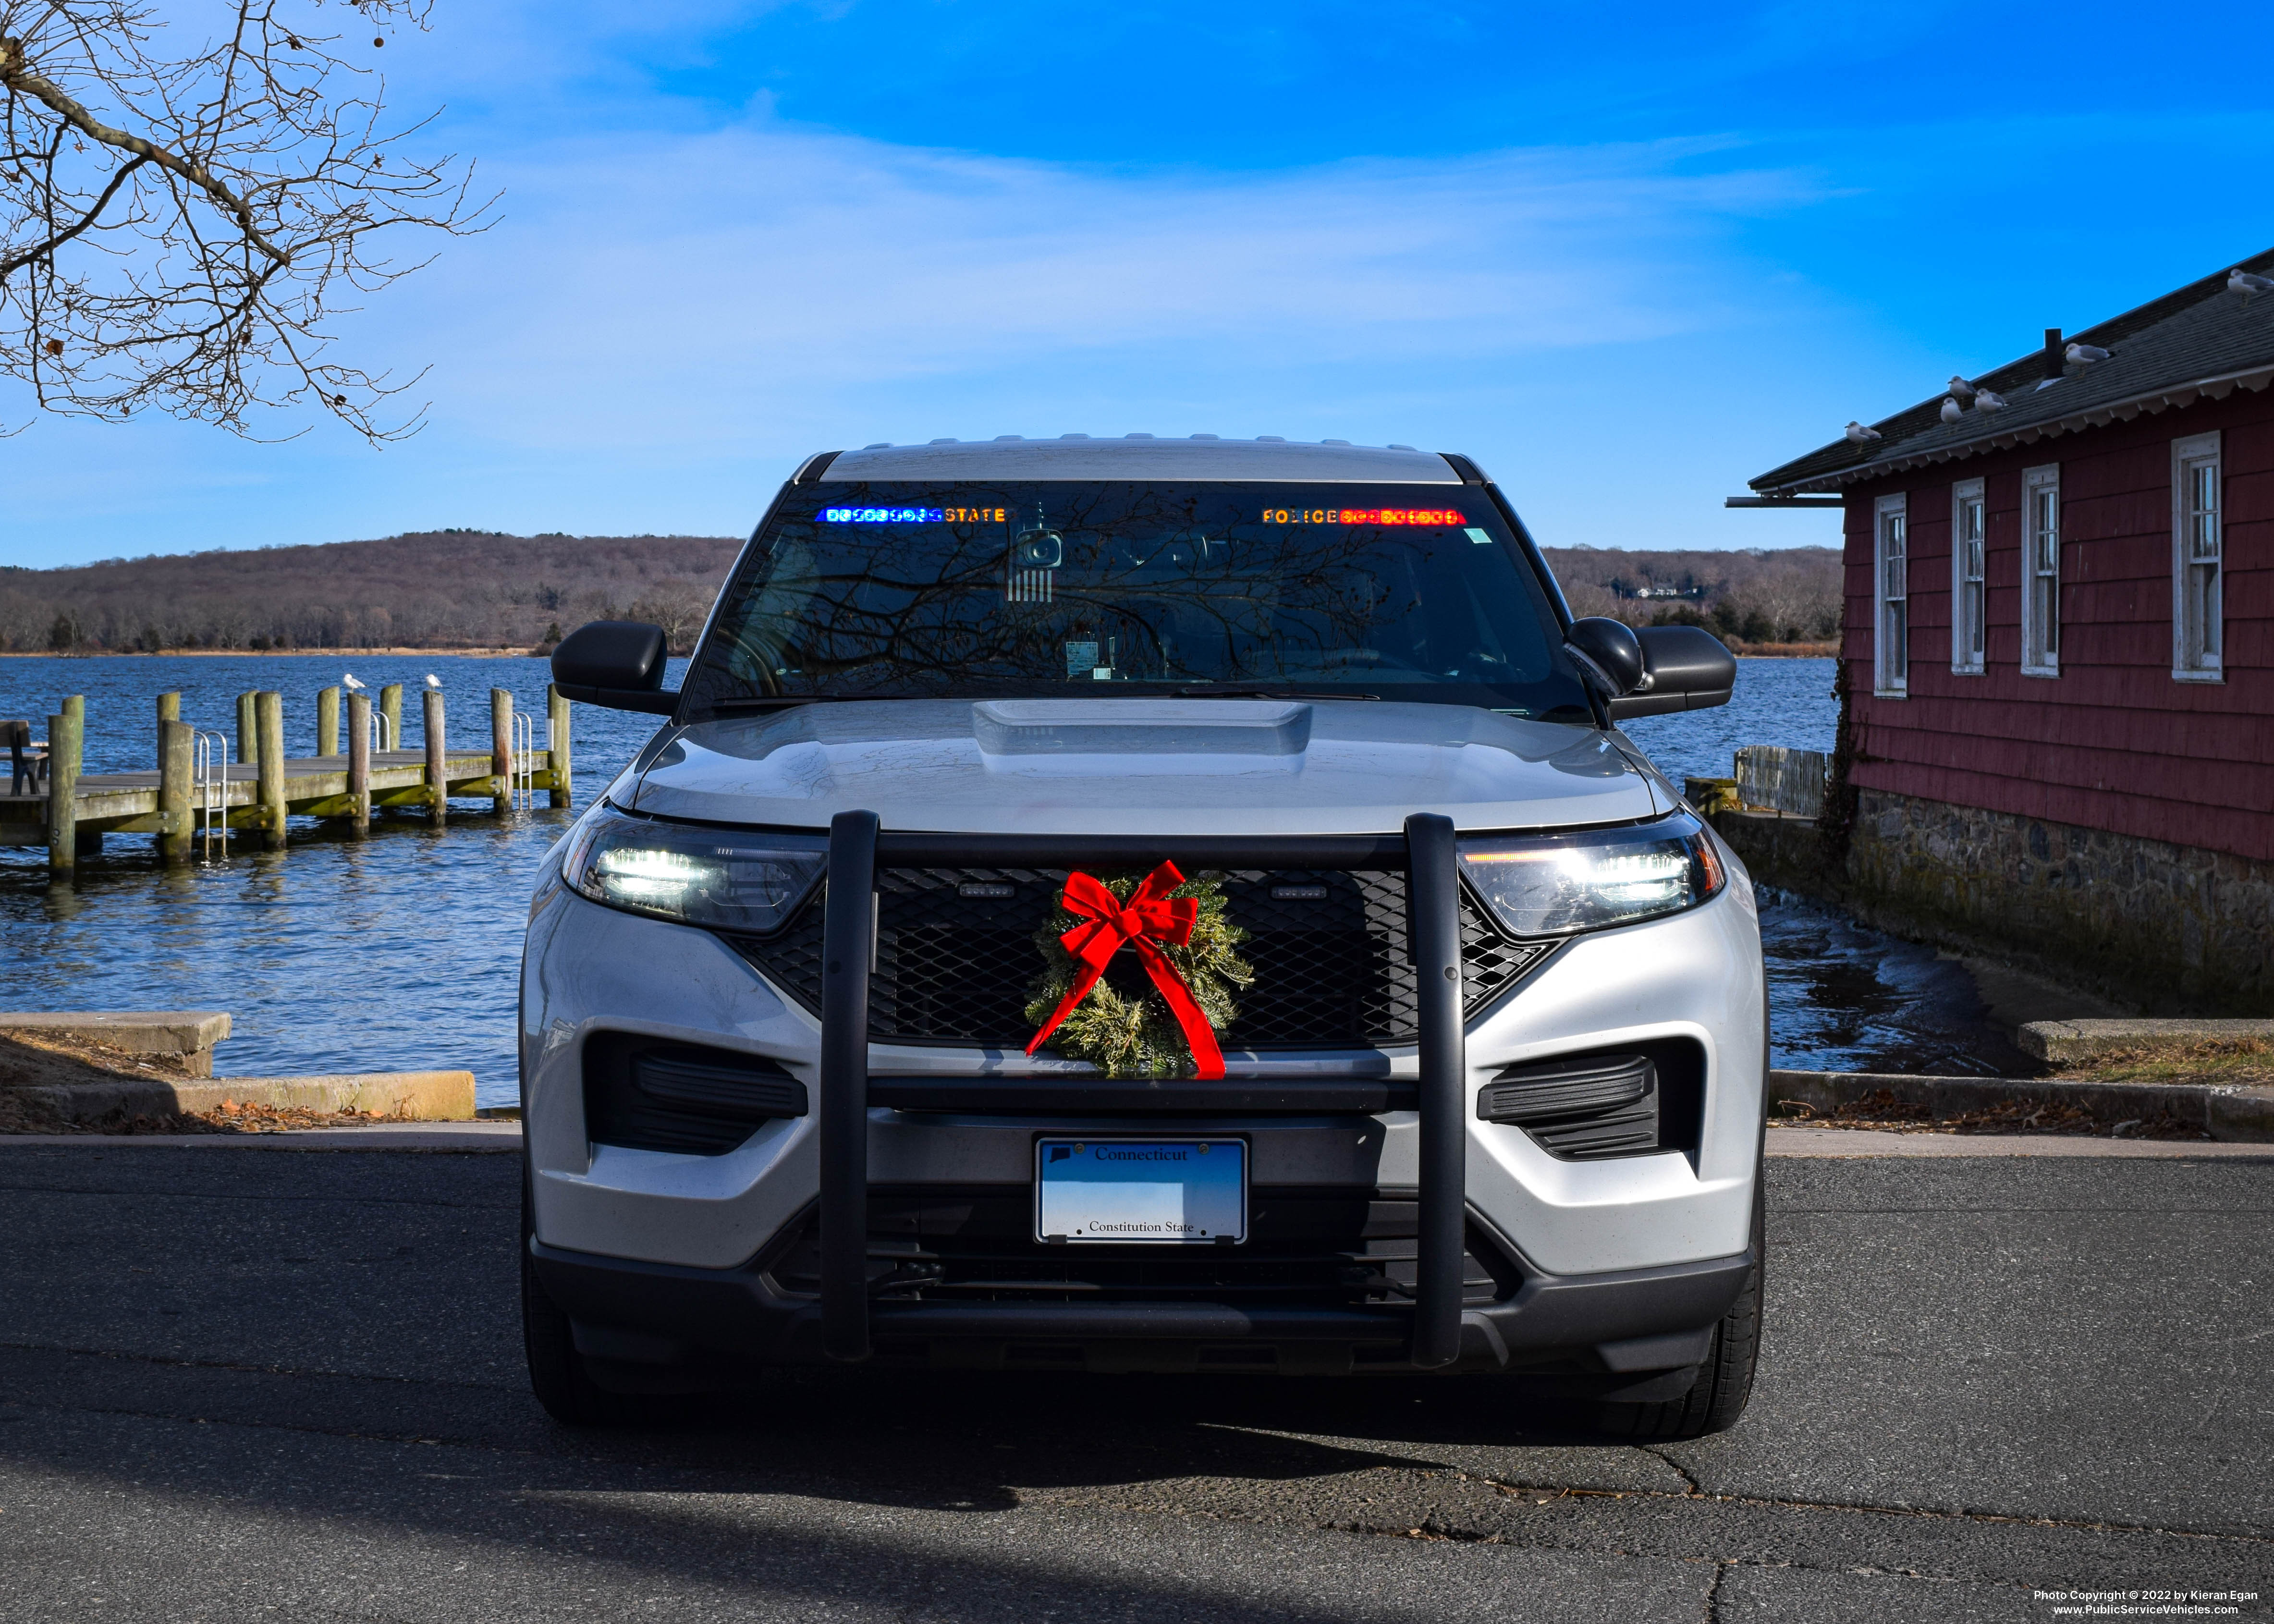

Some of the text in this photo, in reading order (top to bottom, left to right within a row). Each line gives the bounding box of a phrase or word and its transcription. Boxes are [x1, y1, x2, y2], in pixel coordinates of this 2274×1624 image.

[945, 508, 1005, 522] STATE
[1095, 1147, 1188, 1161] Connecticut
[1089, 1221, 1194, 1233] Constitution State
